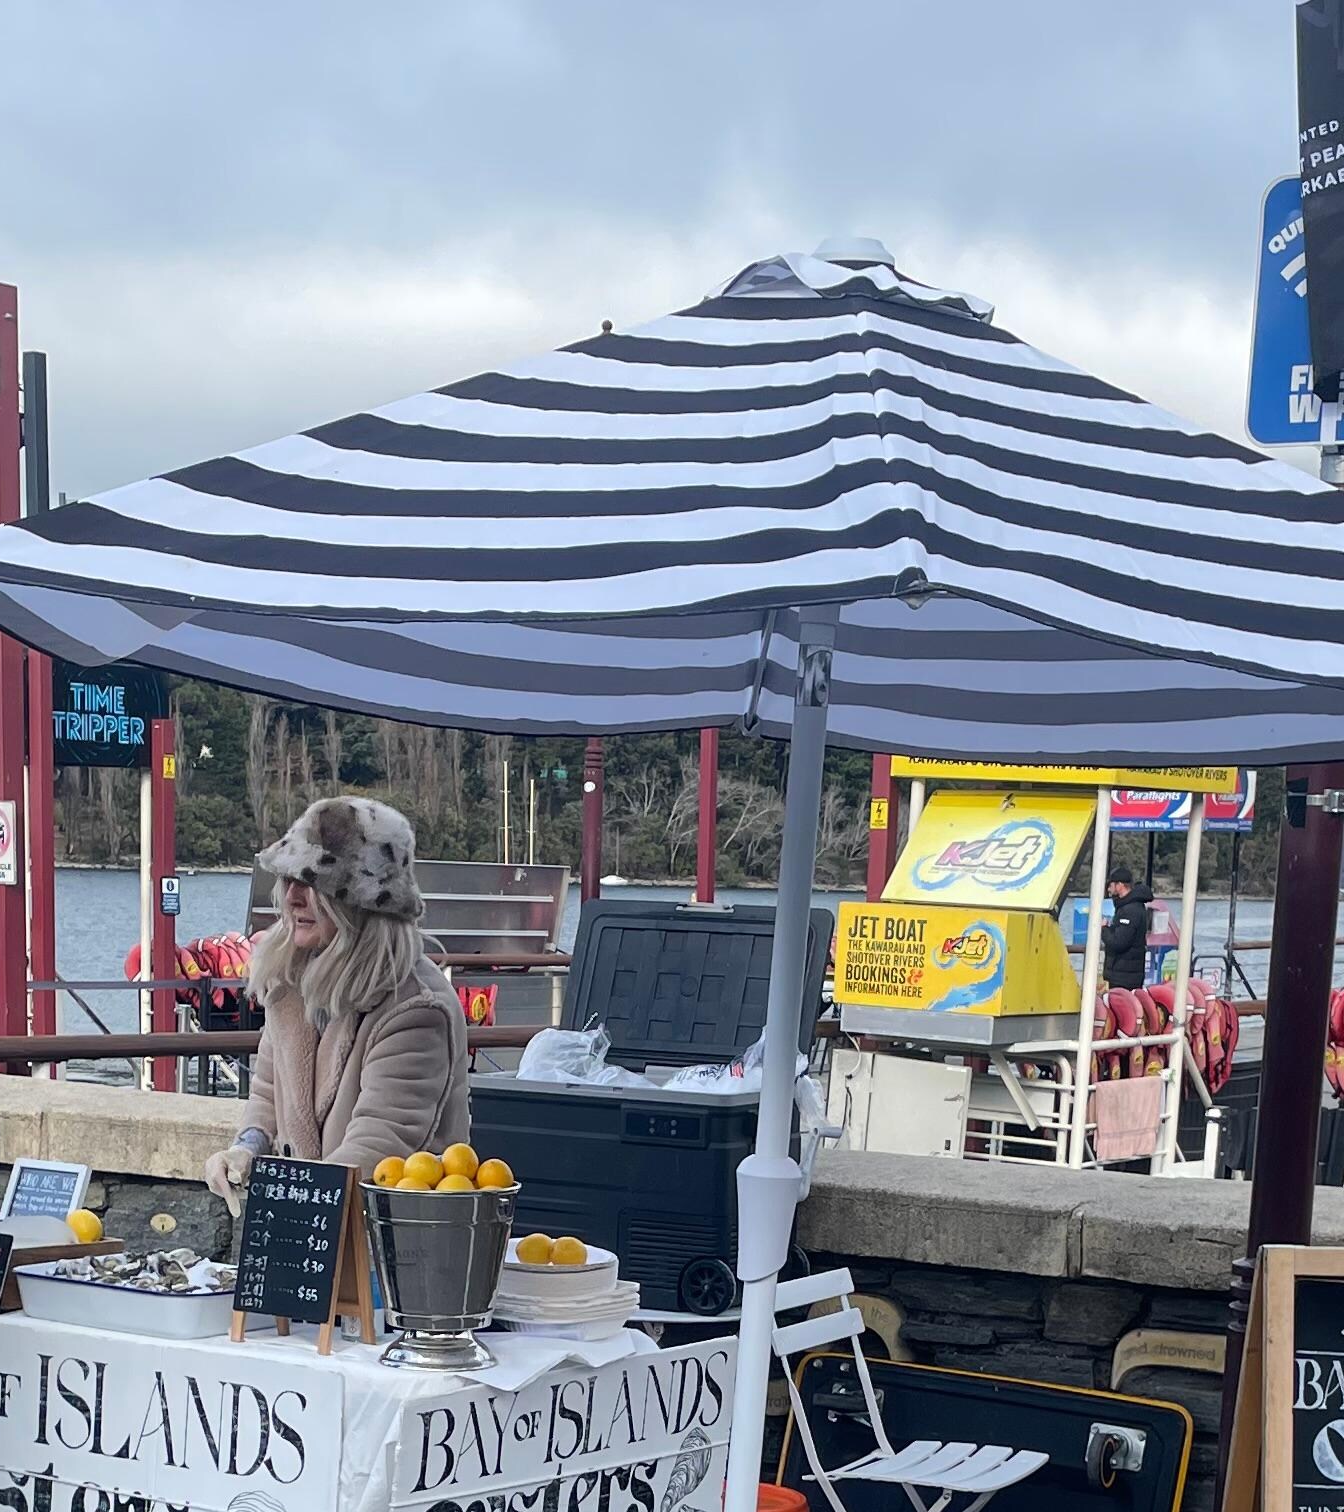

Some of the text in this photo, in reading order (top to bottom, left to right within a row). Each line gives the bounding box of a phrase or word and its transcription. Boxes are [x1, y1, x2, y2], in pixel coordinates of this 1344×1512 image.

[70, 683, 125, 714] TIME
[53, 711, 144, 744] TRIPPER
[849, 916, 927, 942] JET BOAT
[848, 940, 926, 954] THE KAWARAU AND
[846, 952, 924, 968] SHOTOVER RIVERS
[846, 965, 923, 985] BOOKINGS &
[845, 982, 922, 998] INFORMATION HERE
[312, 1214, 327, 1230] $6
[307, 1234, 329, 1250] $10
[303, 1258, 324, 1273] $30
[298, 1285, 318, 1301] $55
[33, 1354, 307, 1485] ISLANDS
[410, 1391, 519, 1494] BAY
[543, 1351, 728, 1464] ISLANDS
